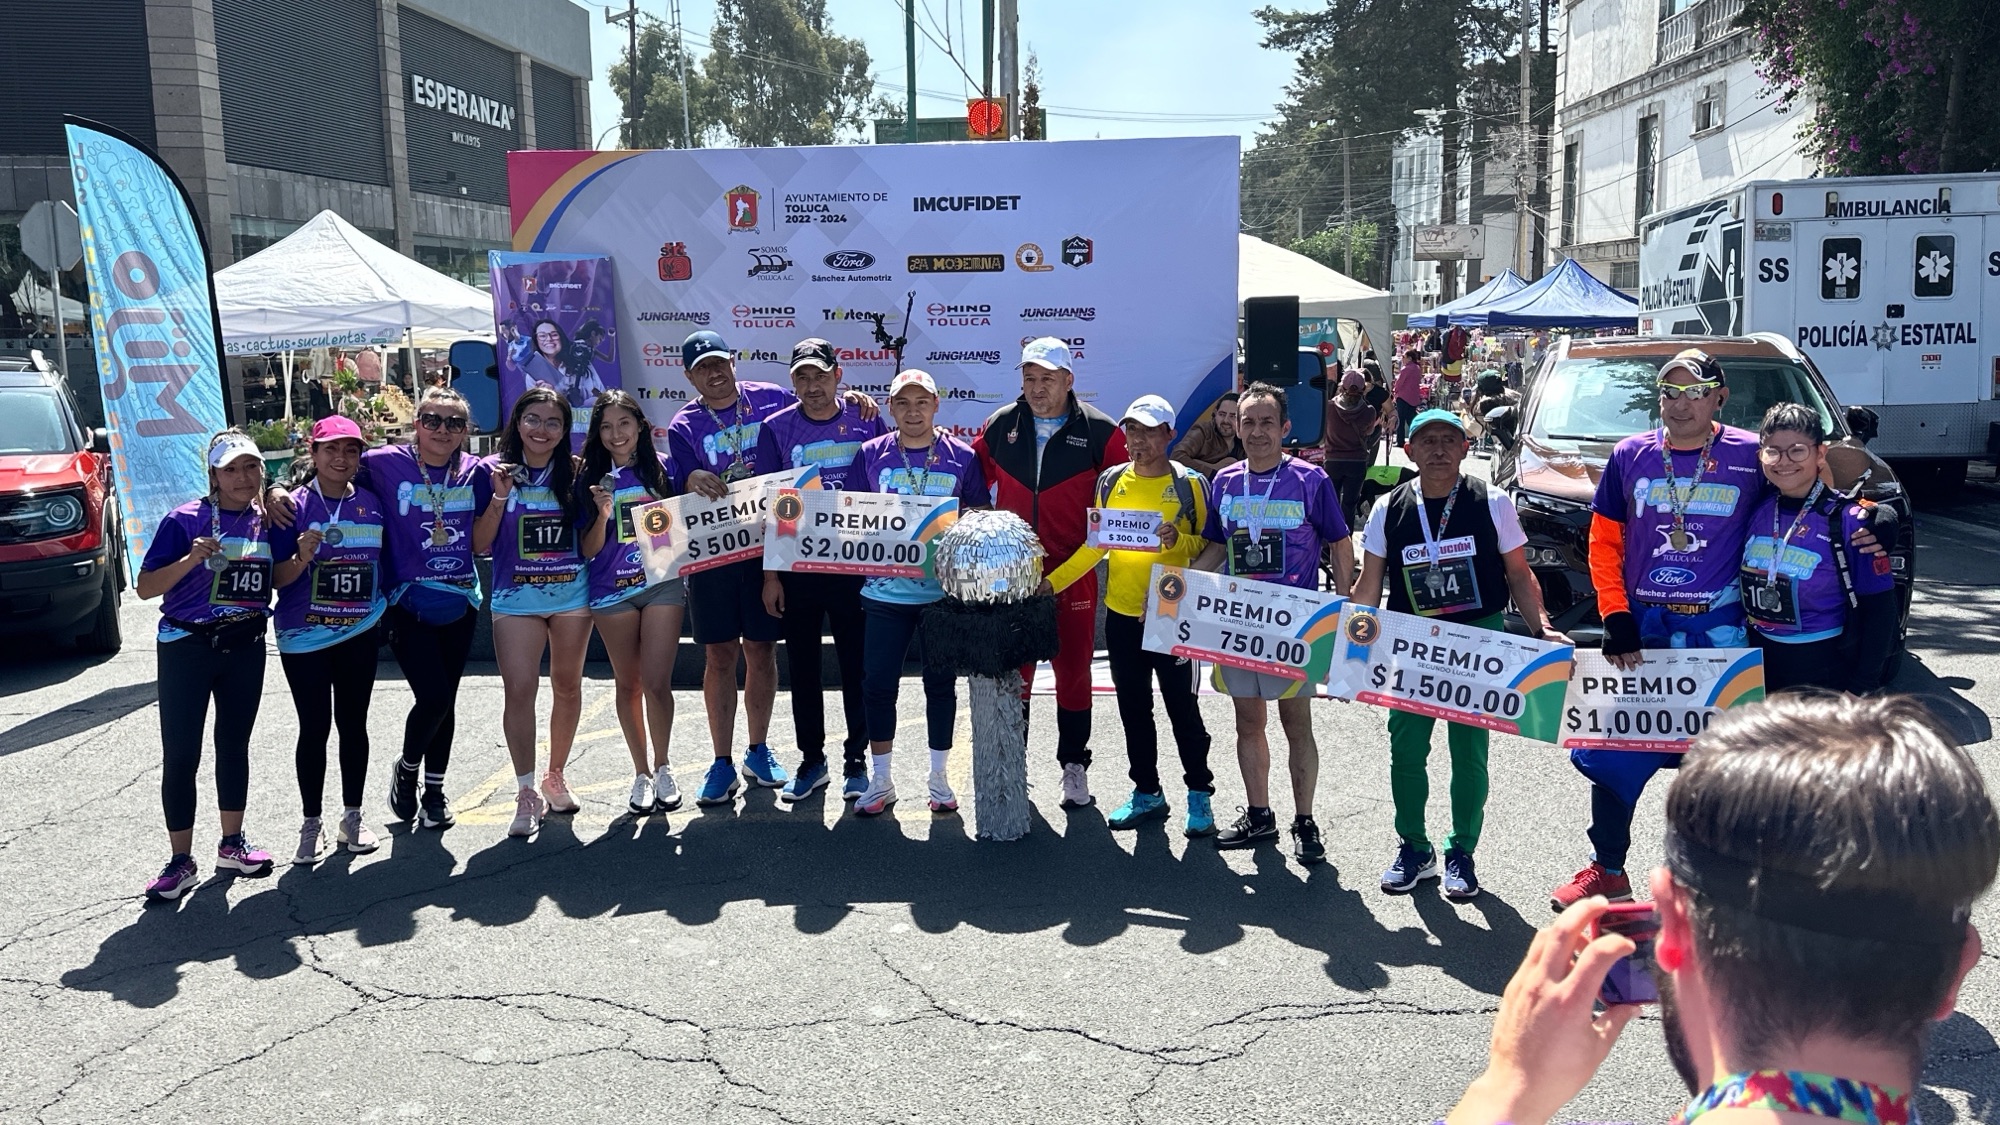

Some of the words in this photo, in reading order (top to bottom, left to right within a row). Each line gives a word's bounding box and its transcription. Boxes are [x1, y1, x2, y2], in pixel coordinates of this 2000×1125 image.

[784, 192, 870, 203] AYUNTAMIENTO
[873, 192, 888, 201] DE
[913, 195, 1019, 212] IMCUFIDET
[784, 204, 829, 213] TOLUCA
[784, 215, 811, 223] 2022
[821, 214, 847, 223] 2024
[761, 245, 788, 254] SOMOS
[832, 252, 866, 268] Ford
[909, 258, 929, 271] LA
[933, 256, 1001, 270] MODERNA
[1758, 257, 1789, 283] SS
[811, 274, 846, 282] Sánchez
[847, 274, 892, 282] Automotriz
[1642, 277, 1662, 311] POLICÍA
[1672, 276, 1696, 307] ESTATAL
[752, 306, 795, 315] HINO
[947, 304, 991, 313] HINO
[1020, 307, 1096, 318] JUNGHANNS
[733, 320, 795, 328] TOLUCA
[927, 318, 991, 326] TOLUCA
[246, 335, 290, 351] cactus
[297, 330, 366, 348] suculentas
[1798, 320, 1868, 348] POLICÍA
[1901, 321, 1977, 346] ESTATAL
[926, 350, 1000, 361] JUNGHANNS
[710, 521, 732, 531] QUINTO
[815, 512, 907, 531] PREMIO
[1107, 519, 1150, 530] PREMIO
[535, 526, 563, 545] 117
[429, 545, 455, 553] TOLUCA
[1663, 555, 1690, 563] TOLUCA
[231, 571, 263, 592] 149
[331, 573, 361, 593] 151
[1655, 568, 1687, 585] Ford
[1163, 578, 1176, 594] 4
[1635, 588, 1666, 598] Sánchez
[310, 604, 341, 613] Sánchez
[1196, 595, 1292, 626] PREMIO
[1219, 617, 1243, 626] CUARTO
[1244, 620, 1265, 629] LUGAR
[1355, 622, 1369, 637] 2
[1177, 620, 1191, 643] $
[1219, 630, 1305, 665] 750.00
[1392, 638, 1504, 675] PREMIO
[1417, 661, 1451, 674] SEGUNDO
[1452, 668, 1476, 679] LUGAR
[1582, 676, 1697, 695] PREMIO
